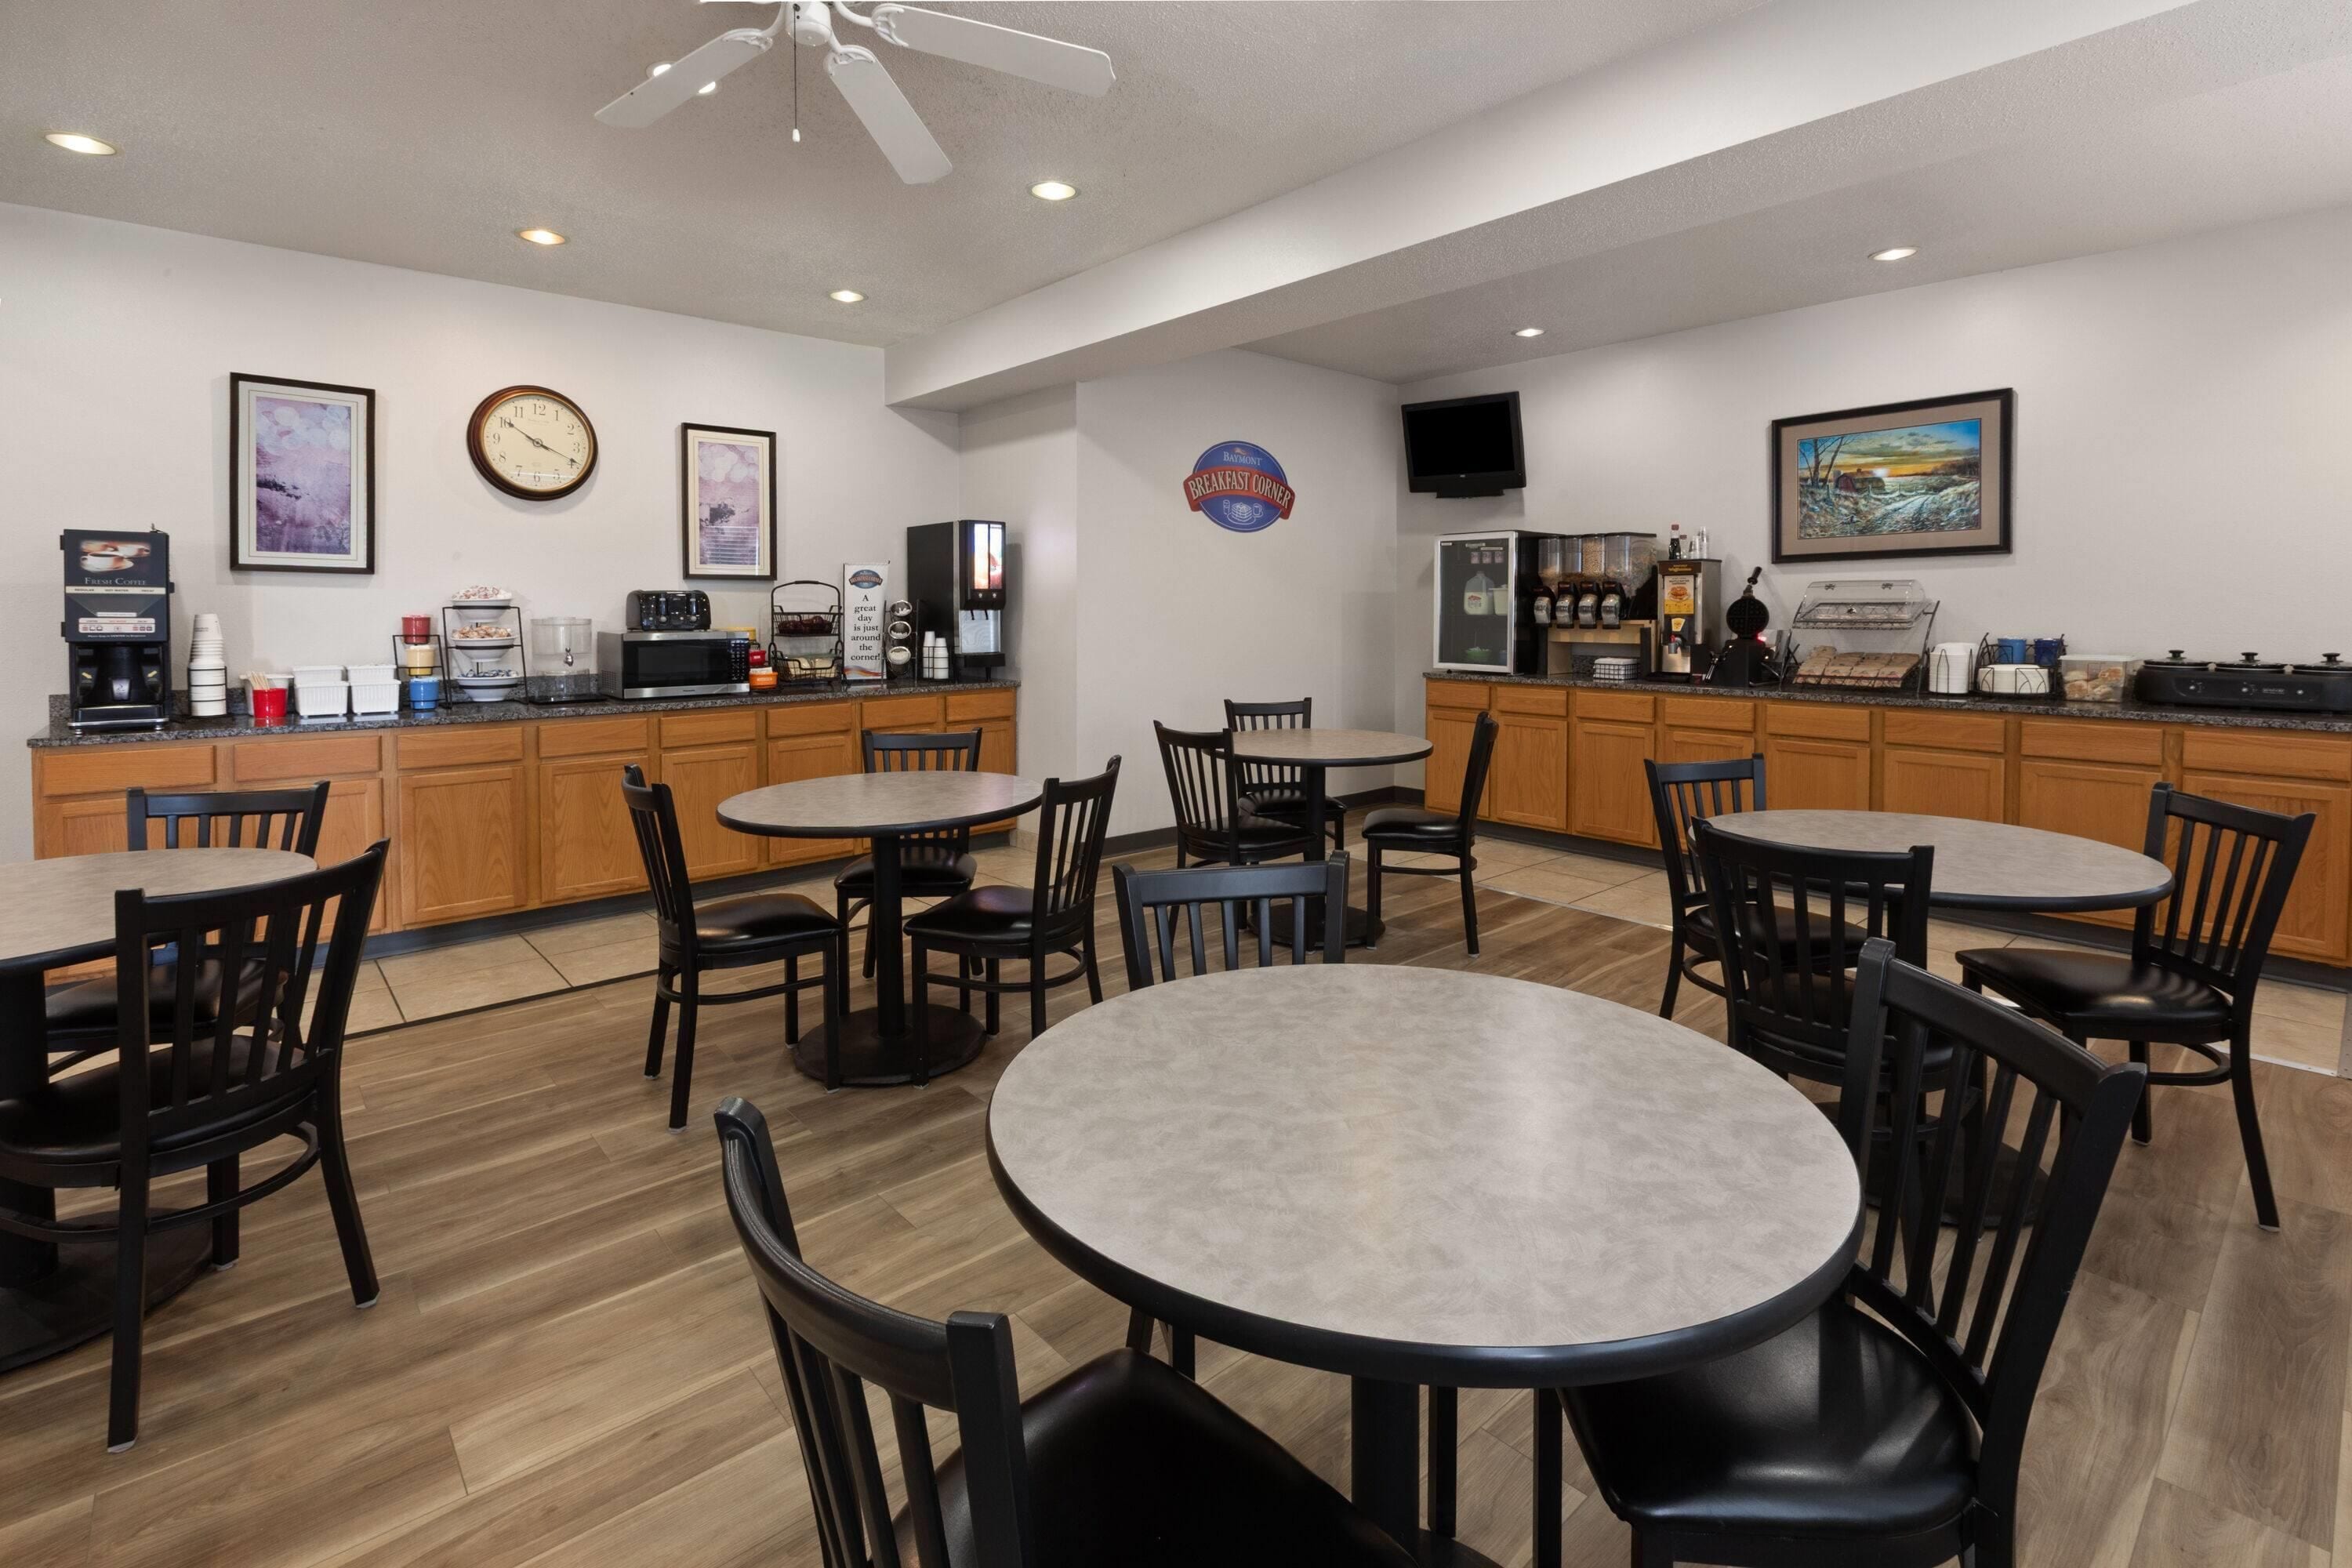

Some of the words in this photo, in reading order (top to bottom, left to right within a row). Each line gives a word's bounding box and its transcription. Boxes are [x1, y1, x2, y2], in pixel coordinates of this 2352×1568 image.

[514, 405, 524, 419] 11
[533, 403, 546, 416] 12
[499, 416, 512, 428] 10
[554, 410, 560, 422] 1
[567, 423, 575, 435] 2
[492, 433, 501, 445] 9
[572, 441, 580, 454] 3
[499, 452, 506, 463] 8
[1223, 451, 1263, 466] BAYMONT
[515, 465, 523, 477] 7
[533, 471, 541, 483] 6
[553, 469, 561, 481] 5
[1188, 470, 1250, 501] BREAKFAST
[1252, 474, 1291, 509] CORNER
[85, 577, 112, 586] FRESH
[854, 605, 876, 614] great
[858, 614, 873, 623] day
[862, 623, 879, 633] just
